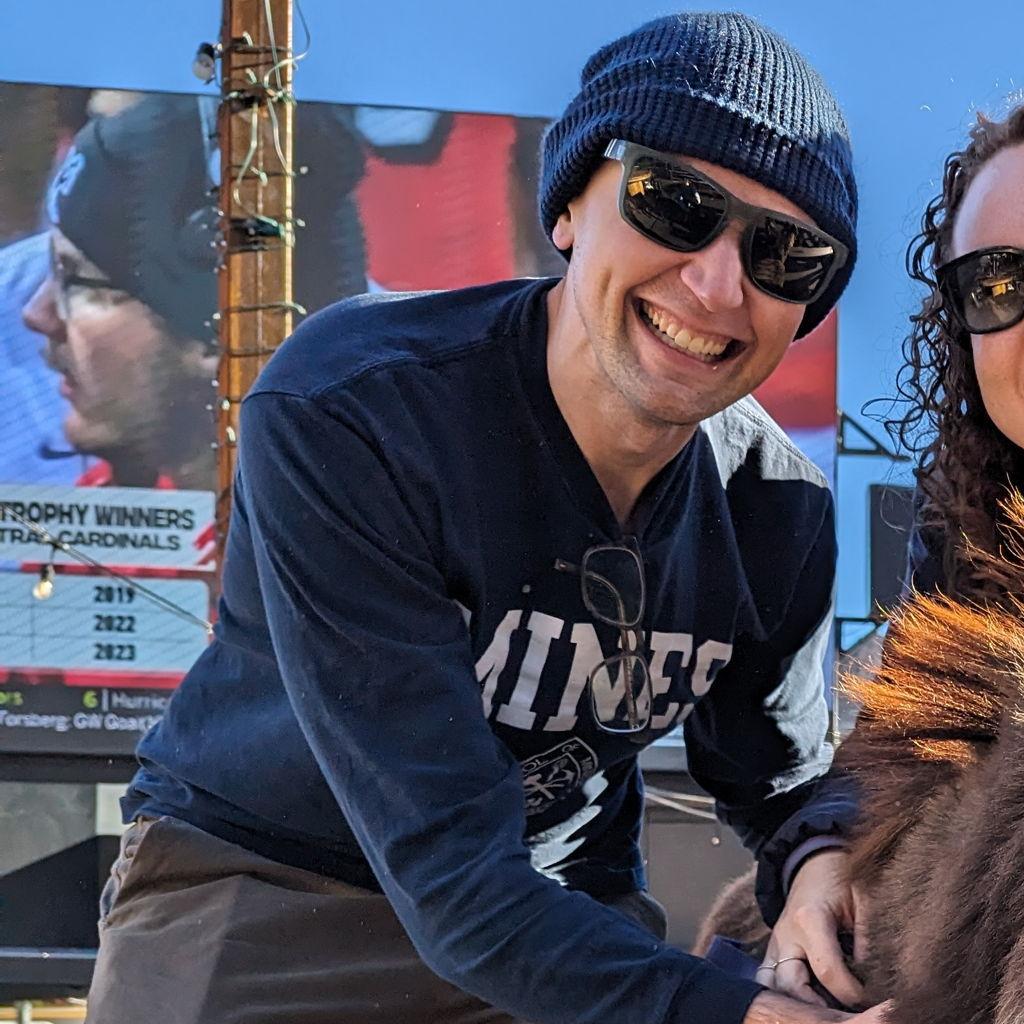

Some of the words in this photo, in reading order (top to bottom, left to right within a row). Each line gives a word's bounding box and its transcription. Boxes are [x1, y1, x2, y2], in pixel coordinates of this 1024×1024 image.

[0, 501, 88, 525] TROPHY
[94, 504, 195, 530] WINNERS
[0, 528, 52, 545] TRA
[57, 530, 181, 551] CARDINALS
[93, 585, 136, 604] 2019
[93, 614, 136, 633] 2022
[93, 643, 136, 661] 2023
[83, 691, 98, 708] 6
